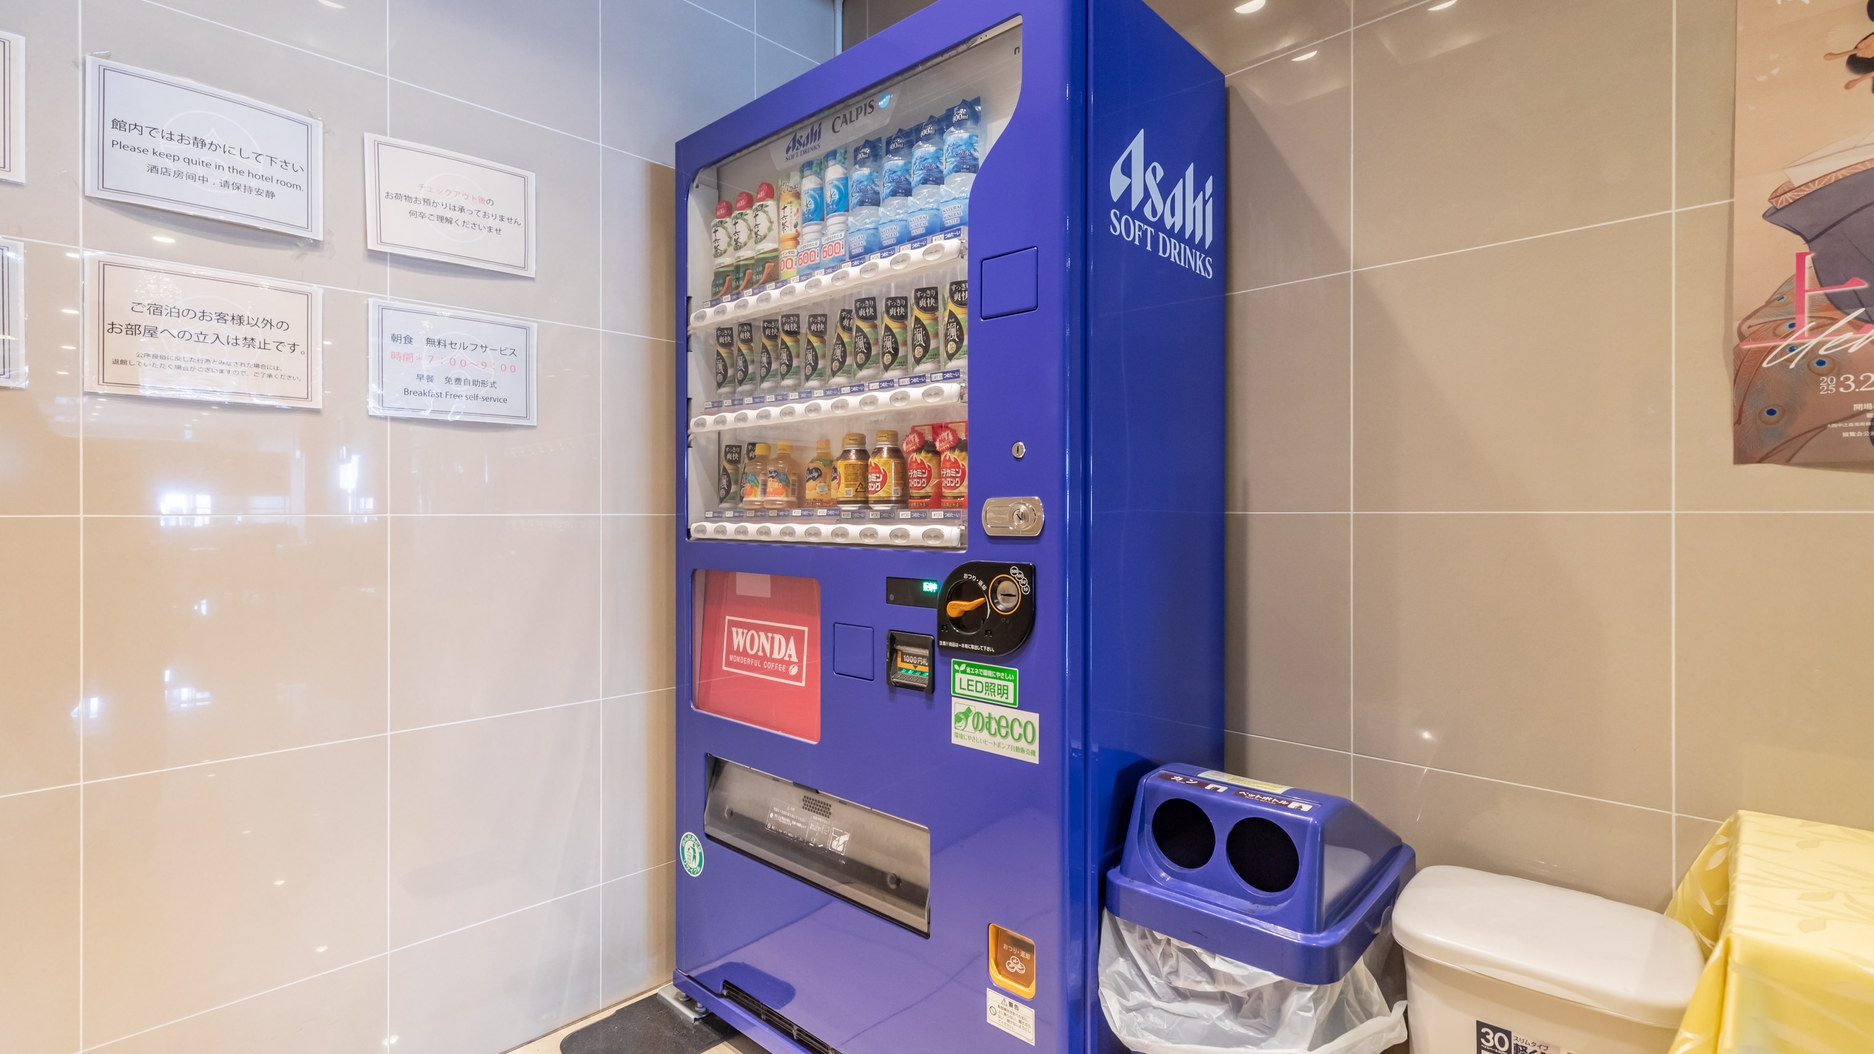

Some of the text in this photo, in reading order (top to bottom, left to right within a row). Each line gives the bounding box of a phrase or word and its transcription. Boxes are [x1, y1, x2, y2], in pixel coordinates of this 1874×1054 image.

[832, 99, 875, 134] CALPIS
[111, 118, 304, 173] 館内ではお静かにして下さい
[785, 121, 822, 155] Asahi
[785, 144, 821, 162] SOFT DRINKS
[111, 140, 304, 192] Please keep quite in the hotel room.
[418, 183, 495, 207] チェックアウト後の
[1109, 128, 1213, 250] Asahi
[384, 191, 522, 226] お荷物お預かりは承っておりません
[408, 209, 502, 236] 何卒ご理解くださいませ
[822, 241, 841, 259] 600
[1109, 208, 1213, 280] SOFT DRINKS
[798, 250, 817, 266] 600
[856, 300, 874, 308] すっきり
[916, 289, 936, 298] すっきり
[919, 298, 936, 308] 爽快
[131, 301, 290, 332] ご宿泊のお客様以外の
[858, 307, 875, 316] 爽快
[889, 307, 905, 316] 爽快
[106, 321, 306, 356] お部屋への立入は禁止です。
[390, 333, 518, 358] 朝食 無料セルフサービス
[415, 373, 435, 384] 早餐
[403, 387, 508, 405] Breakfast Free self-service
[732, 627, 798, 662] WONDA
[729, 654, 786, 672] WONDERFUL COFFEE
[960, 677, 1009, 700] LED照明
[972, 711, 1036, 745] のむeco
[1171, 775, 1198, 784] カン
[1238, 790, 1290, 806] ペットボトル
[1480, 1027, 1510, 1052] 30
[1513, 1035, 1549, 1051] スリムタイプ
